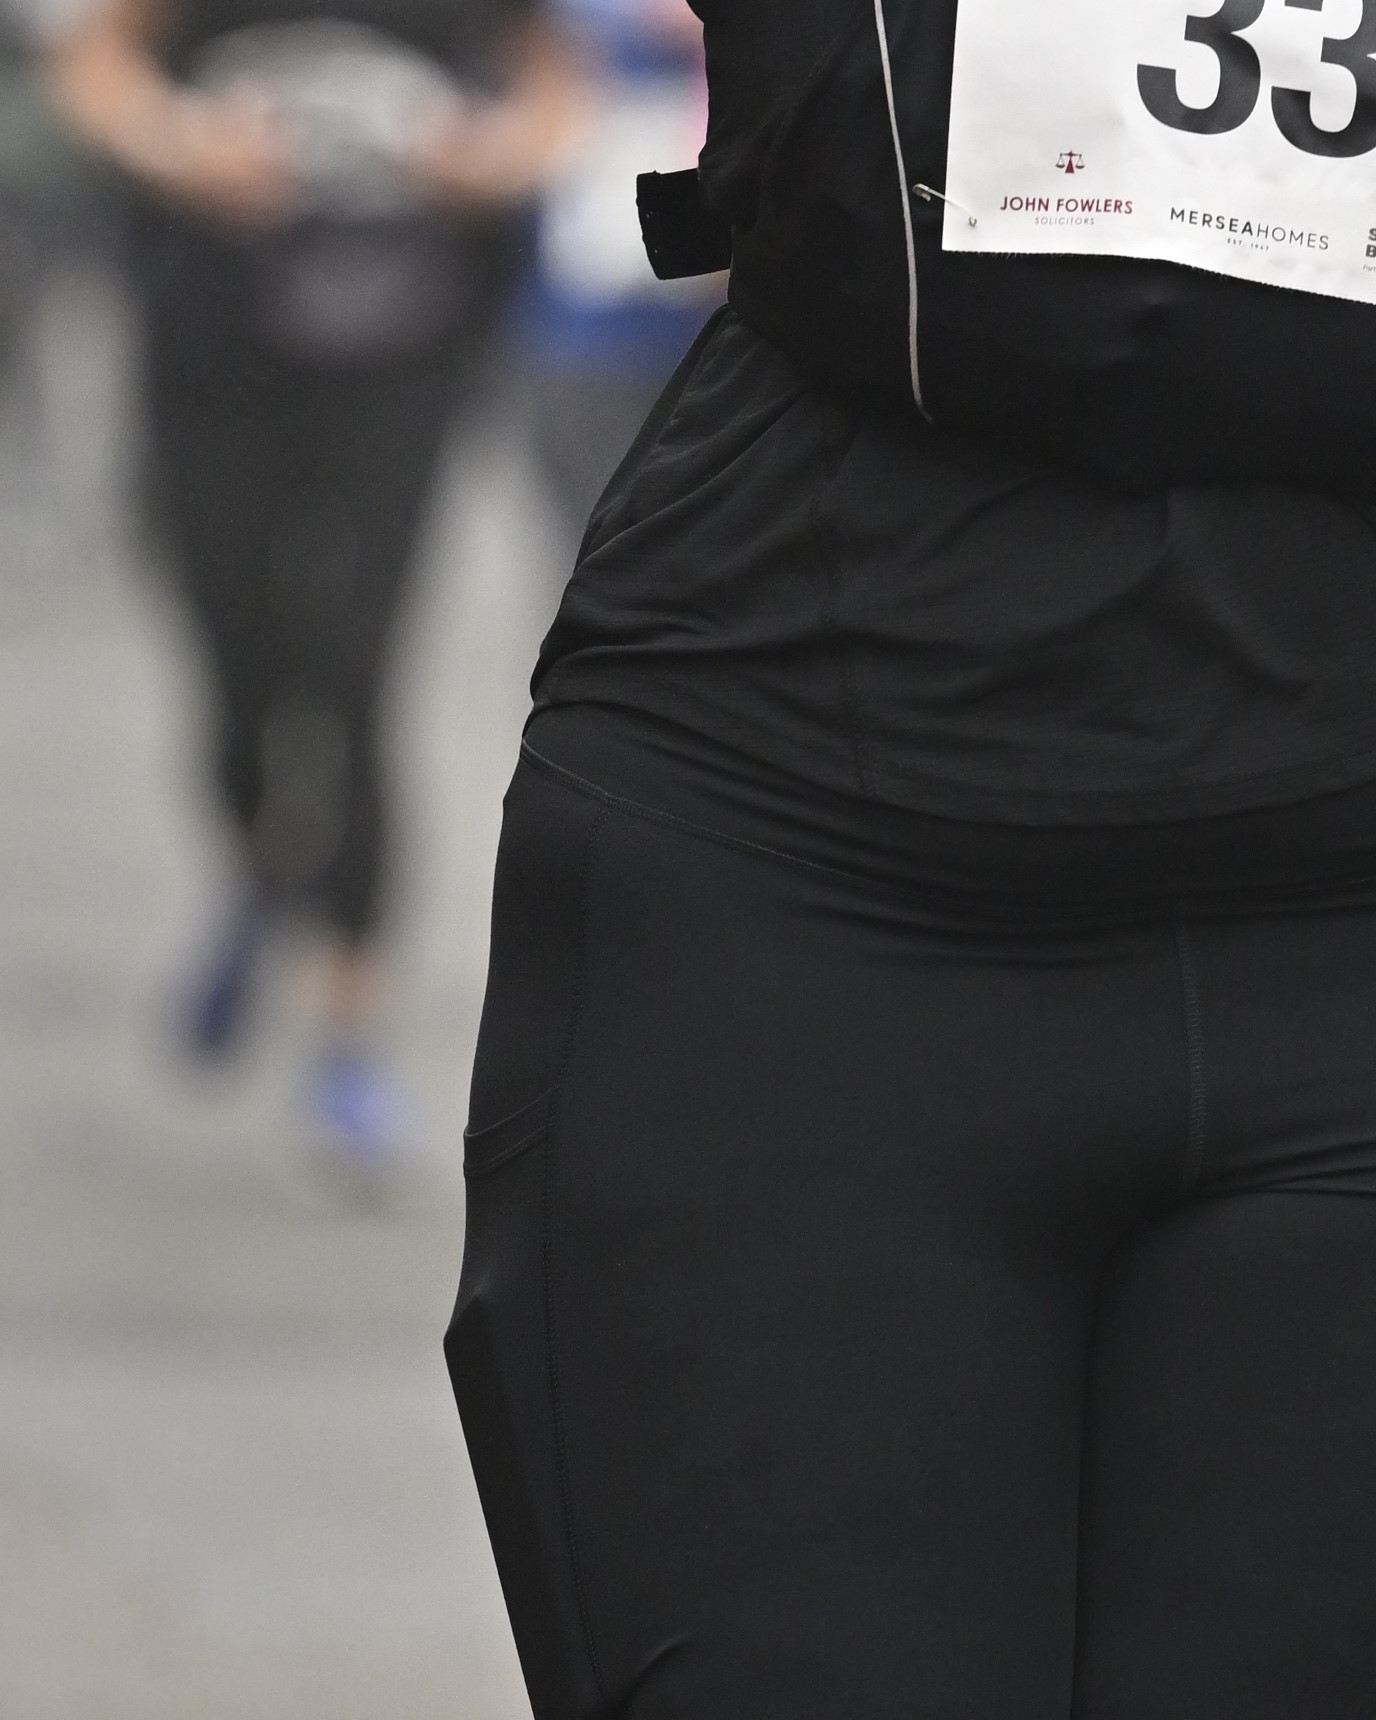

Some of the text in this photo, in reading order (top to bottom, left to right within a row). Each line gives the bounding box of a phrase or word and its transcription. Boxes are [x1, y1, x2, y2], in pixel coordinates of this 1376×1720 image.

[1000, 196, 1133, 214] JOHN FOWLERS
[1034, 217, 1095, 225] SOLICITORS
[1170, 207, 1330, 250] MERSEAHOMES
[1363, 264, 1376, 272] Part
